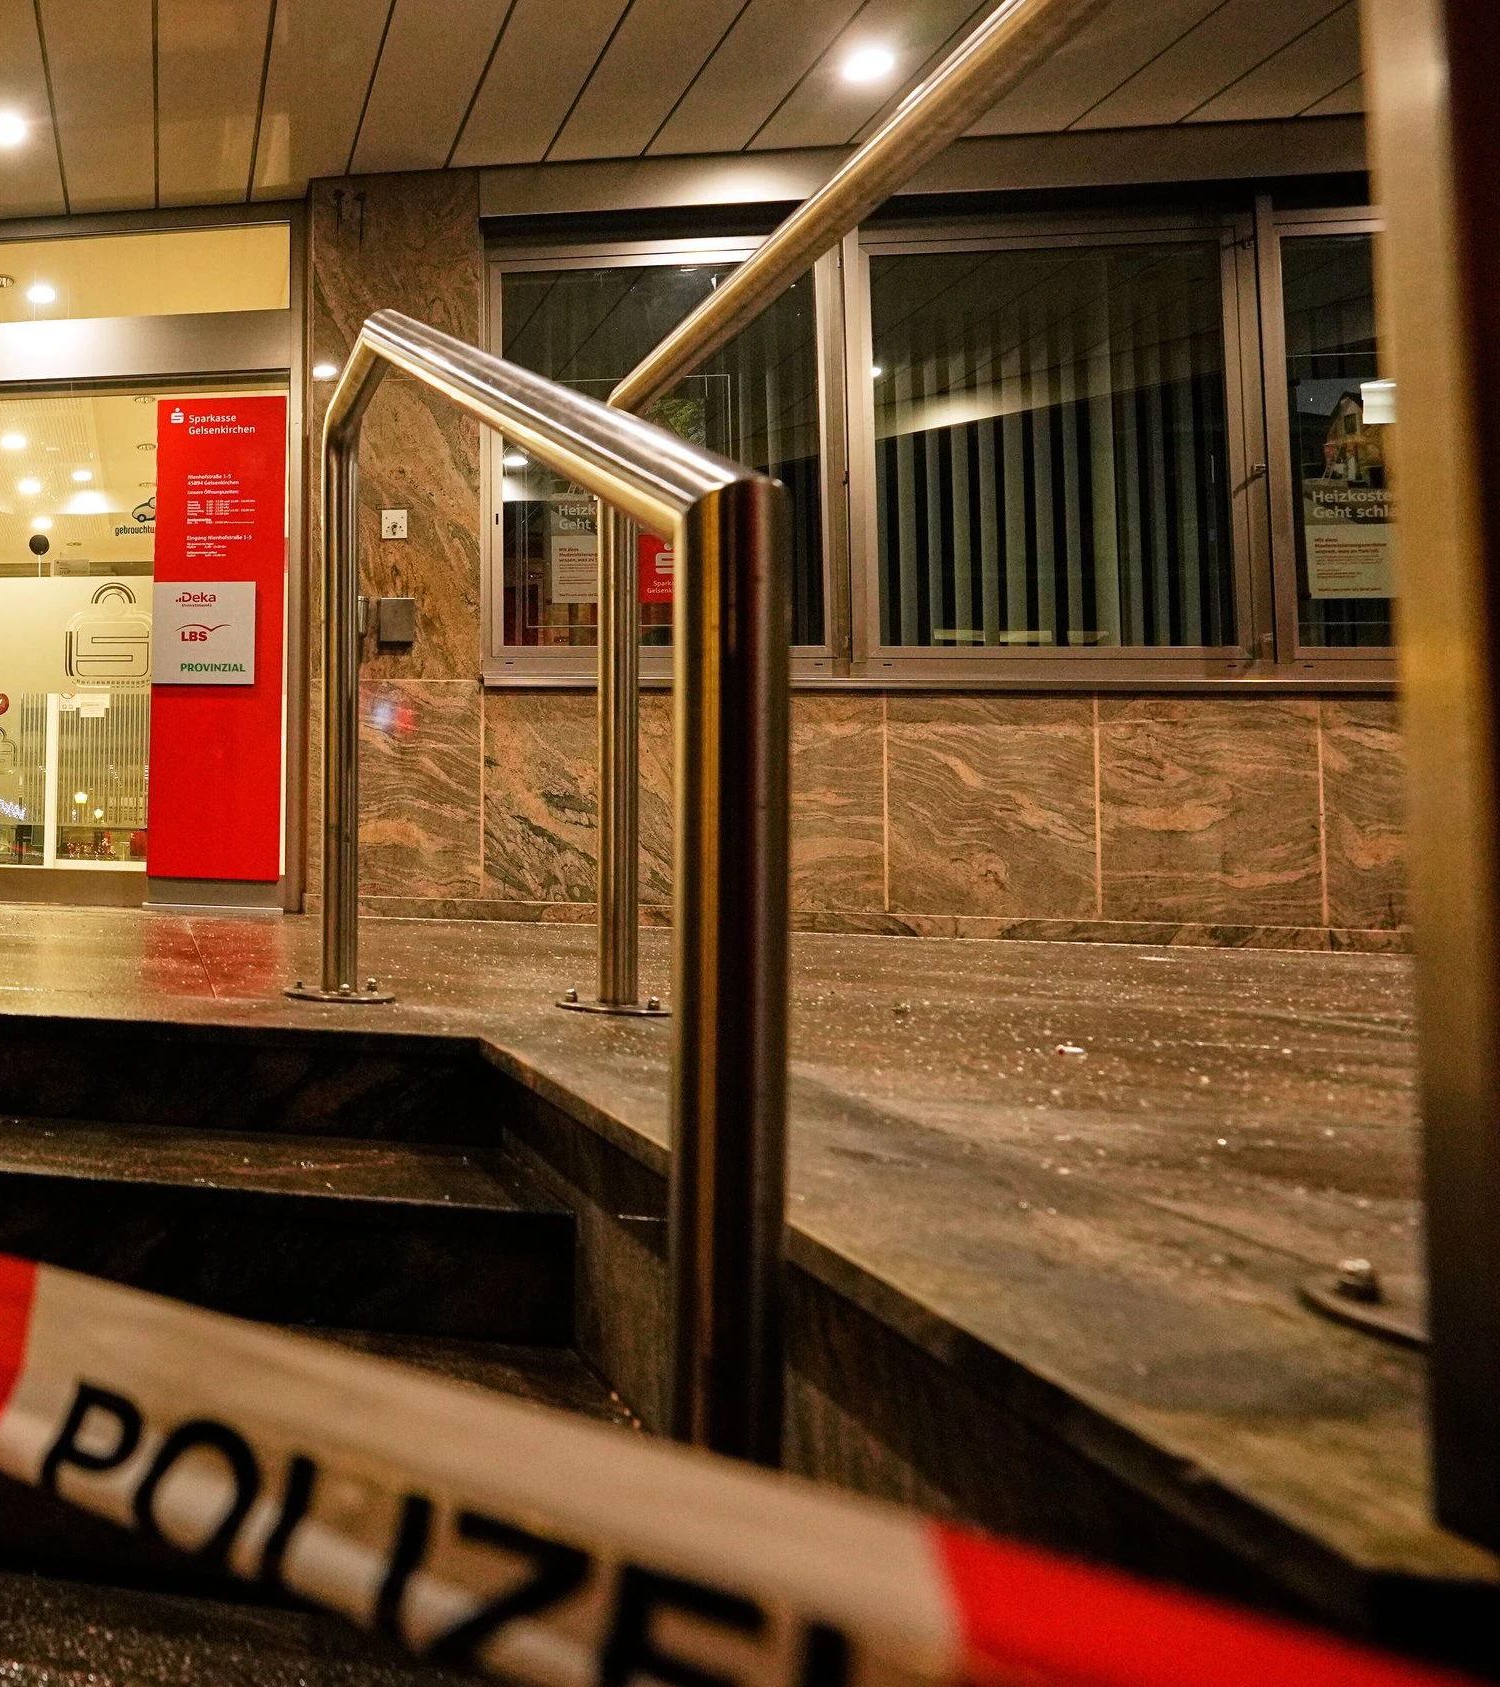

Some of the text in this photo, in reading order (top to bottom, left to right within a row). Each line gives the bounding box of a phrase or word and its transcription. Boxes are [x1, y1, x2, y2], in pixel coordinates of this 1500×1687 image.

[188, 414, 237, 425] Sparkasse
[188, 425, 256, 435] Gelsenkirchen
[558, 503, 597, 517] Heizk
[1313, 505, 1353, 519] Geht
[558, 518, 592, 531] Geht
[181, 591, 217, 603] Deka
[181, 630, 208, 642] LBS
[180, 662, 246, 672] PROVINZIAL
